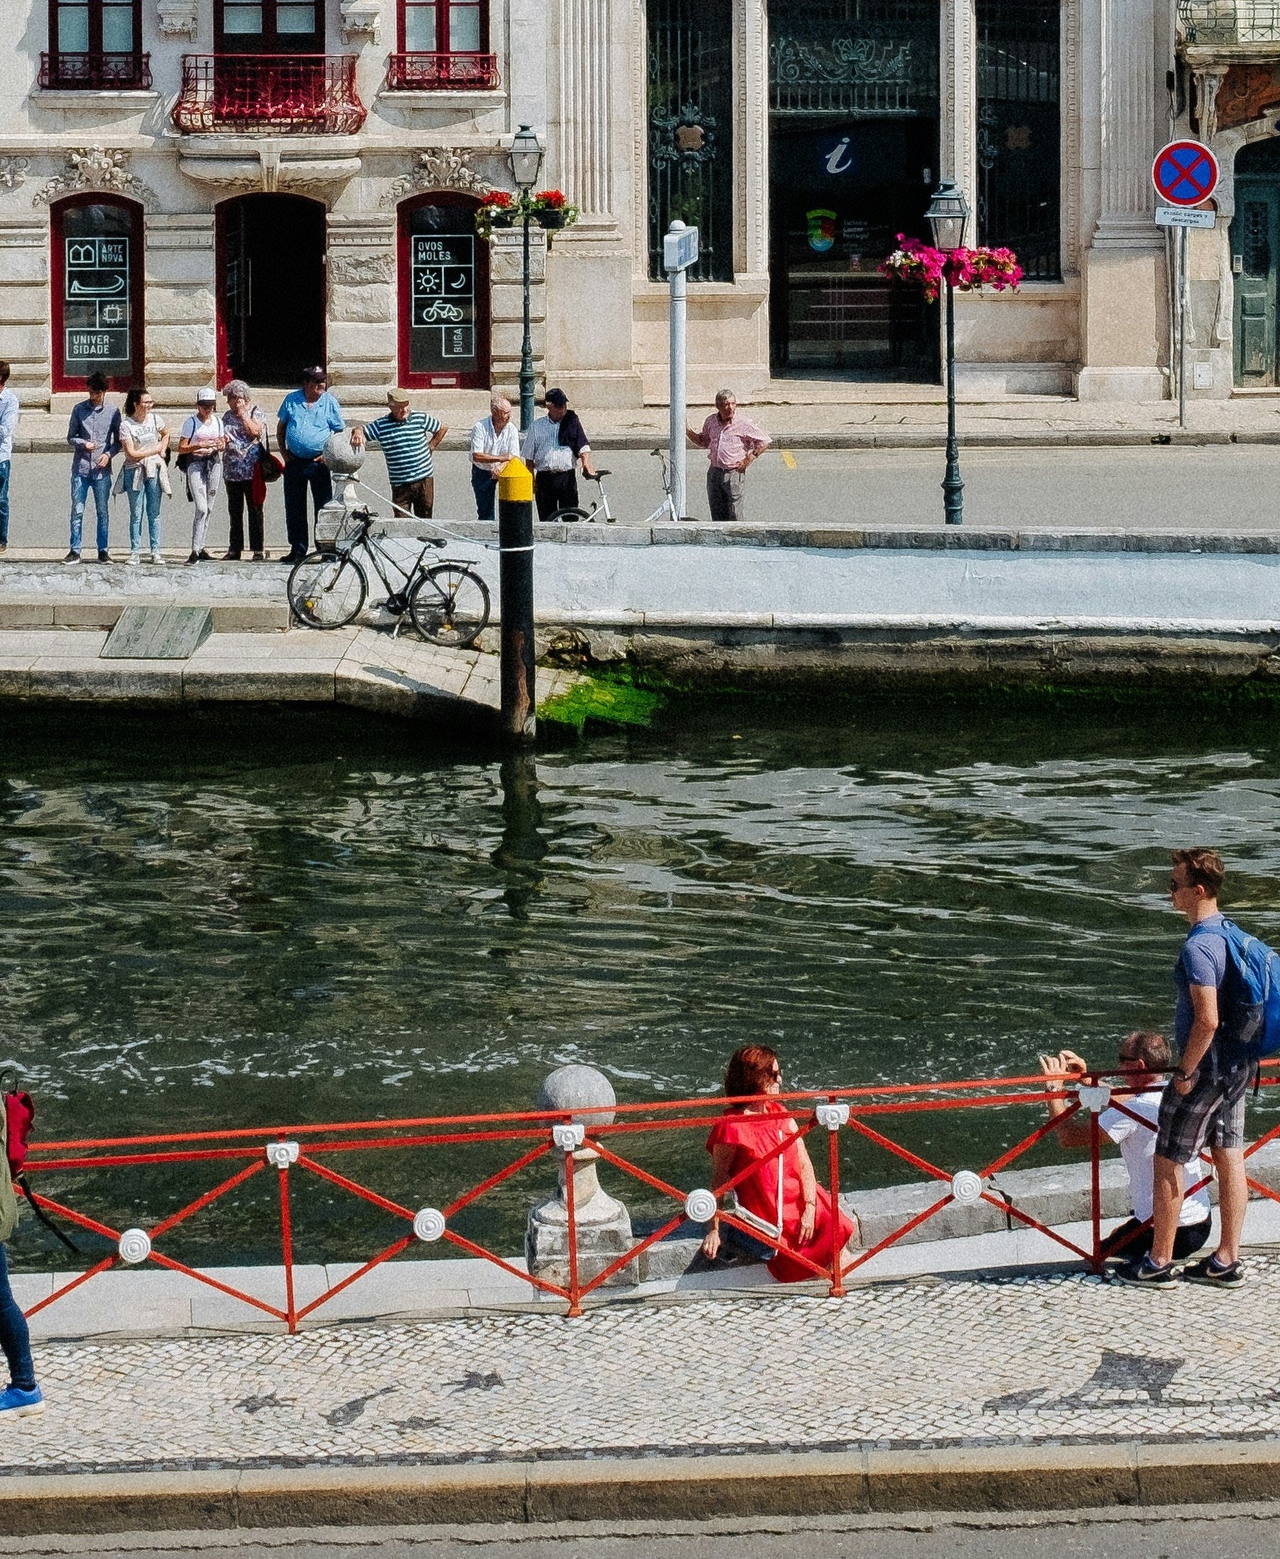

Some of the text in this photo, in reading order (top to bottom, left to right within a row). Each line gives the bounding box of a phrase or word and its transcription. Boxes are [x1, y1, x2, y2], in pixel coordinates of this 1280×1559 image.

[101, 244, 124, 254] ARTE
[418, 241, 443, 251] OVOS
[101, 253, 124, 263] NOVA
[418, 251, 451, 261] MOLES
[73, 334, 115, 345] UNIVER-
[453, 328, 463, 353] BUGA
[73, 345, 110, 354] SIDADE
